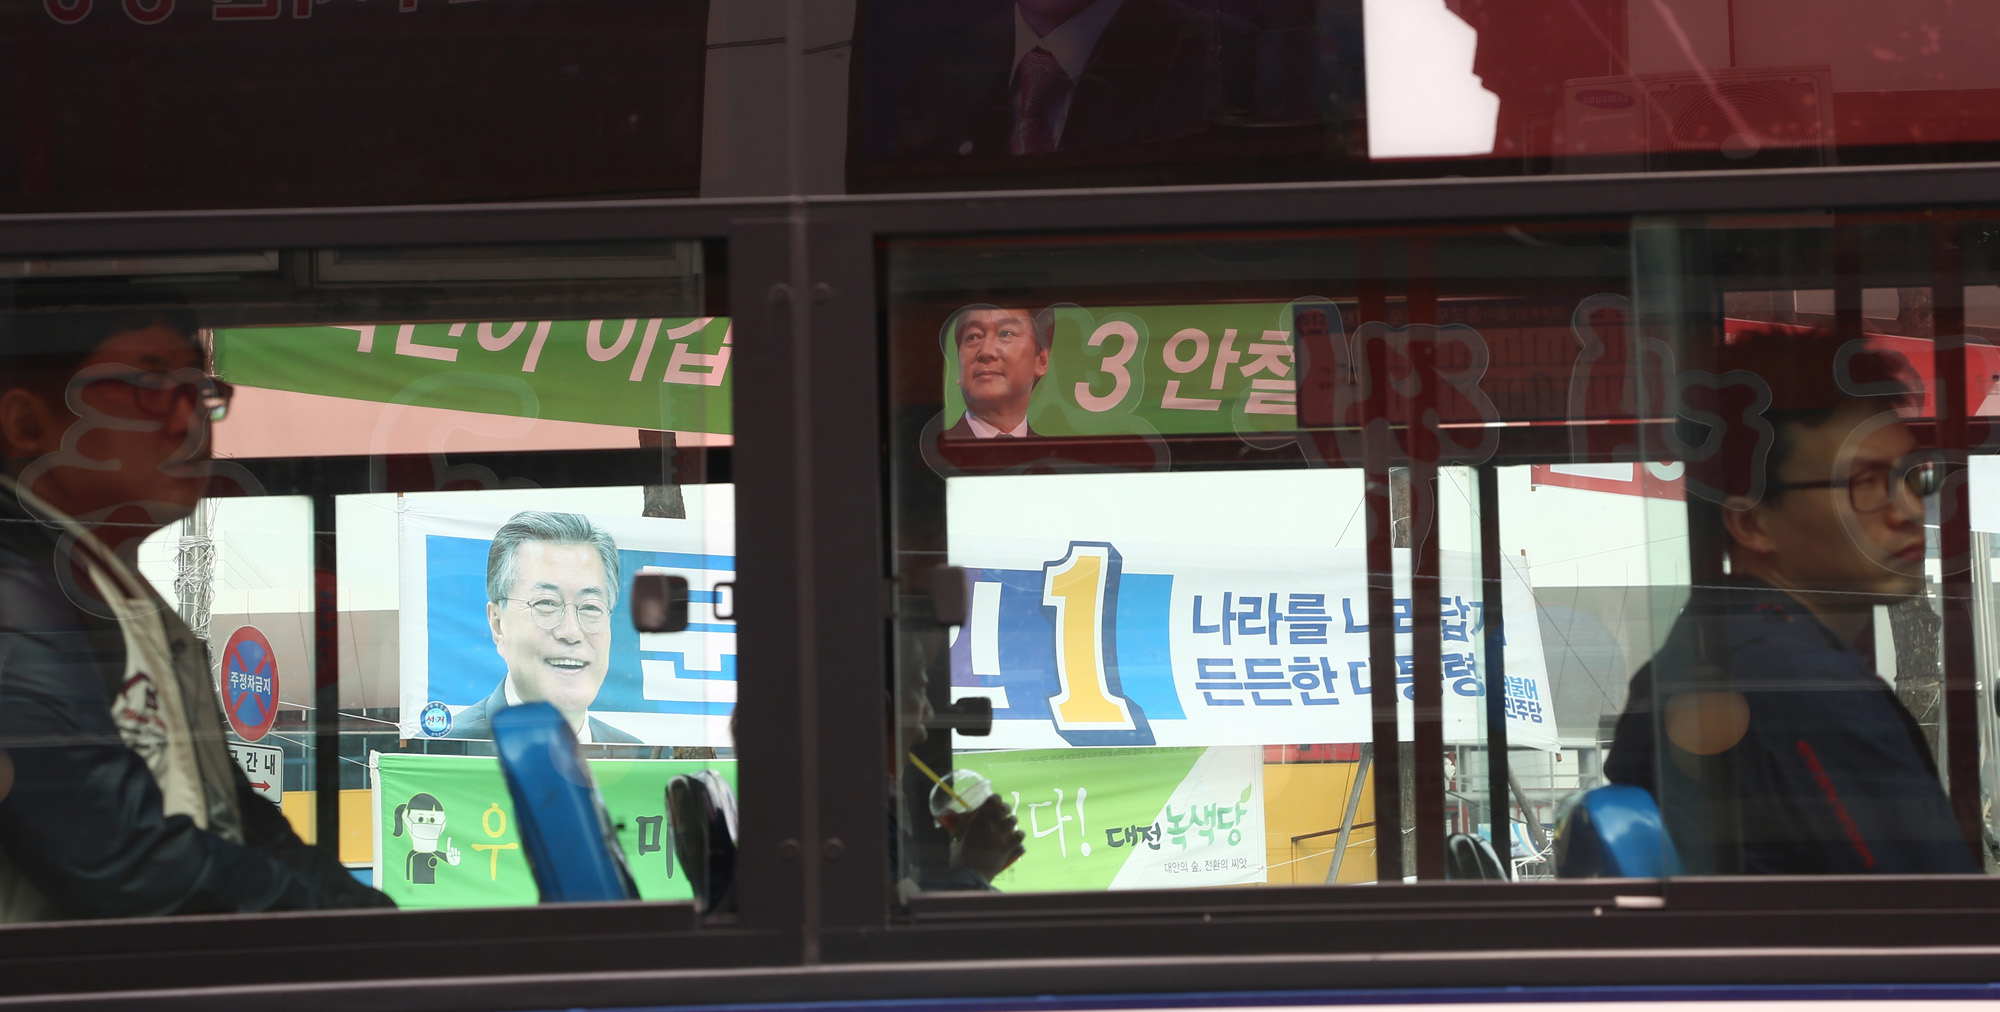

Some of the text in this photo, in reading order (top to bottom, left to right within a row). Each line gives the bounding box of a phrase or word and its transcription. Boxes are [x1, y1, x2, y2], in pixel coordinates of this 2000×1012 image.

[1075, 321, 1138, 412] 3
[1042, 540, 1157, 746] 1
[1193, 592, 1332, 645] 나라를
[230, 671, 271, 695] 주정차금지
[1195, 655, 1340, 706] 든든한
[1505, 697, 1543, 724] 민주당
[1105, 802, 1248, 851] 대전 녹색당
[1164, 861, 1188, 874] 대안의
[1204, 858, 1229, 872] 전환의
[1231, 857, 1248, 869] 씨앗
